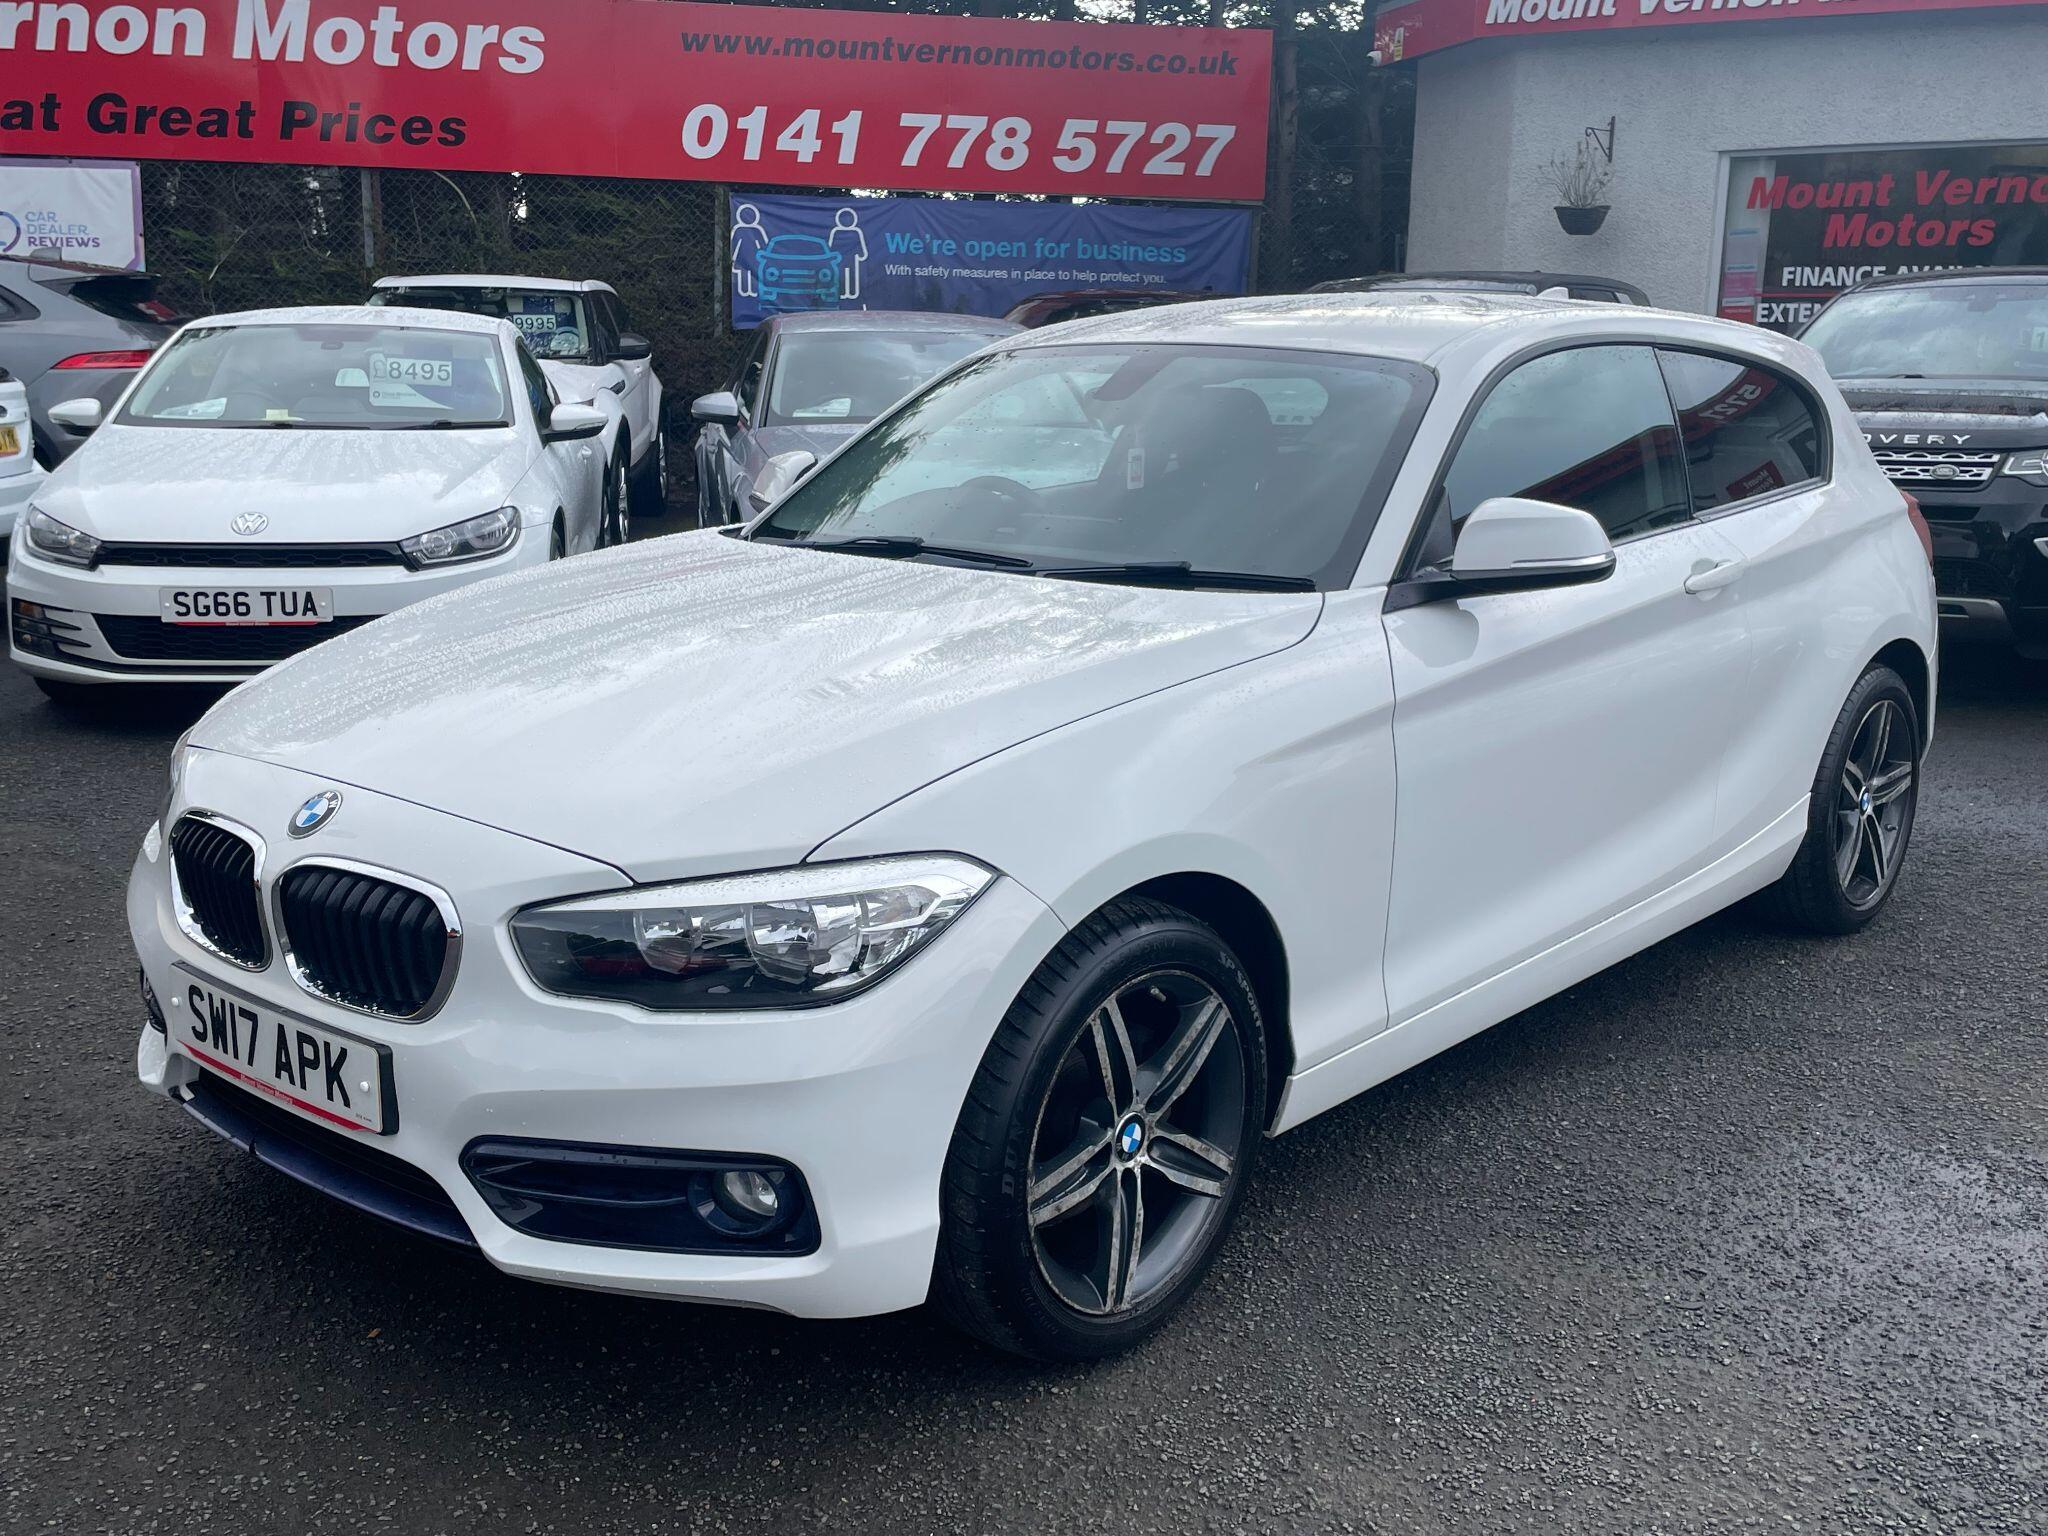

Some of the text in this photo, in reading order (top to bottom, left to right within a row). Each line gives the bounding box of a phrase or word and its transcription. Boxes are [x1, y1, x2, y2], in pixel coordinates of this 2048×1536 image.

[232, 0, 546, 74] Motors
[681, 32, 1239, 76] www.mountvernonmotors.co.uk
[0, 92, 467, 147] at Great Prices
[681, 103, 1237, 177] 0141 778 5727
[1746, 173, 1895, 210] Mount
[25, 211, 58, 222] CAR
[27, 224, 89, 235] DEALER
[1823, 213, 1996, 248] Motors
[28, 236, 101, 247] REVIEWS
[885, 232, 1187, 263] We're open for business
[885, 264, 1167, 285] With safety measures in place to help protect you.
[173, 591, 318, 617] SG66 TUA
[188, 984, 351, 1109] SW17 APK
